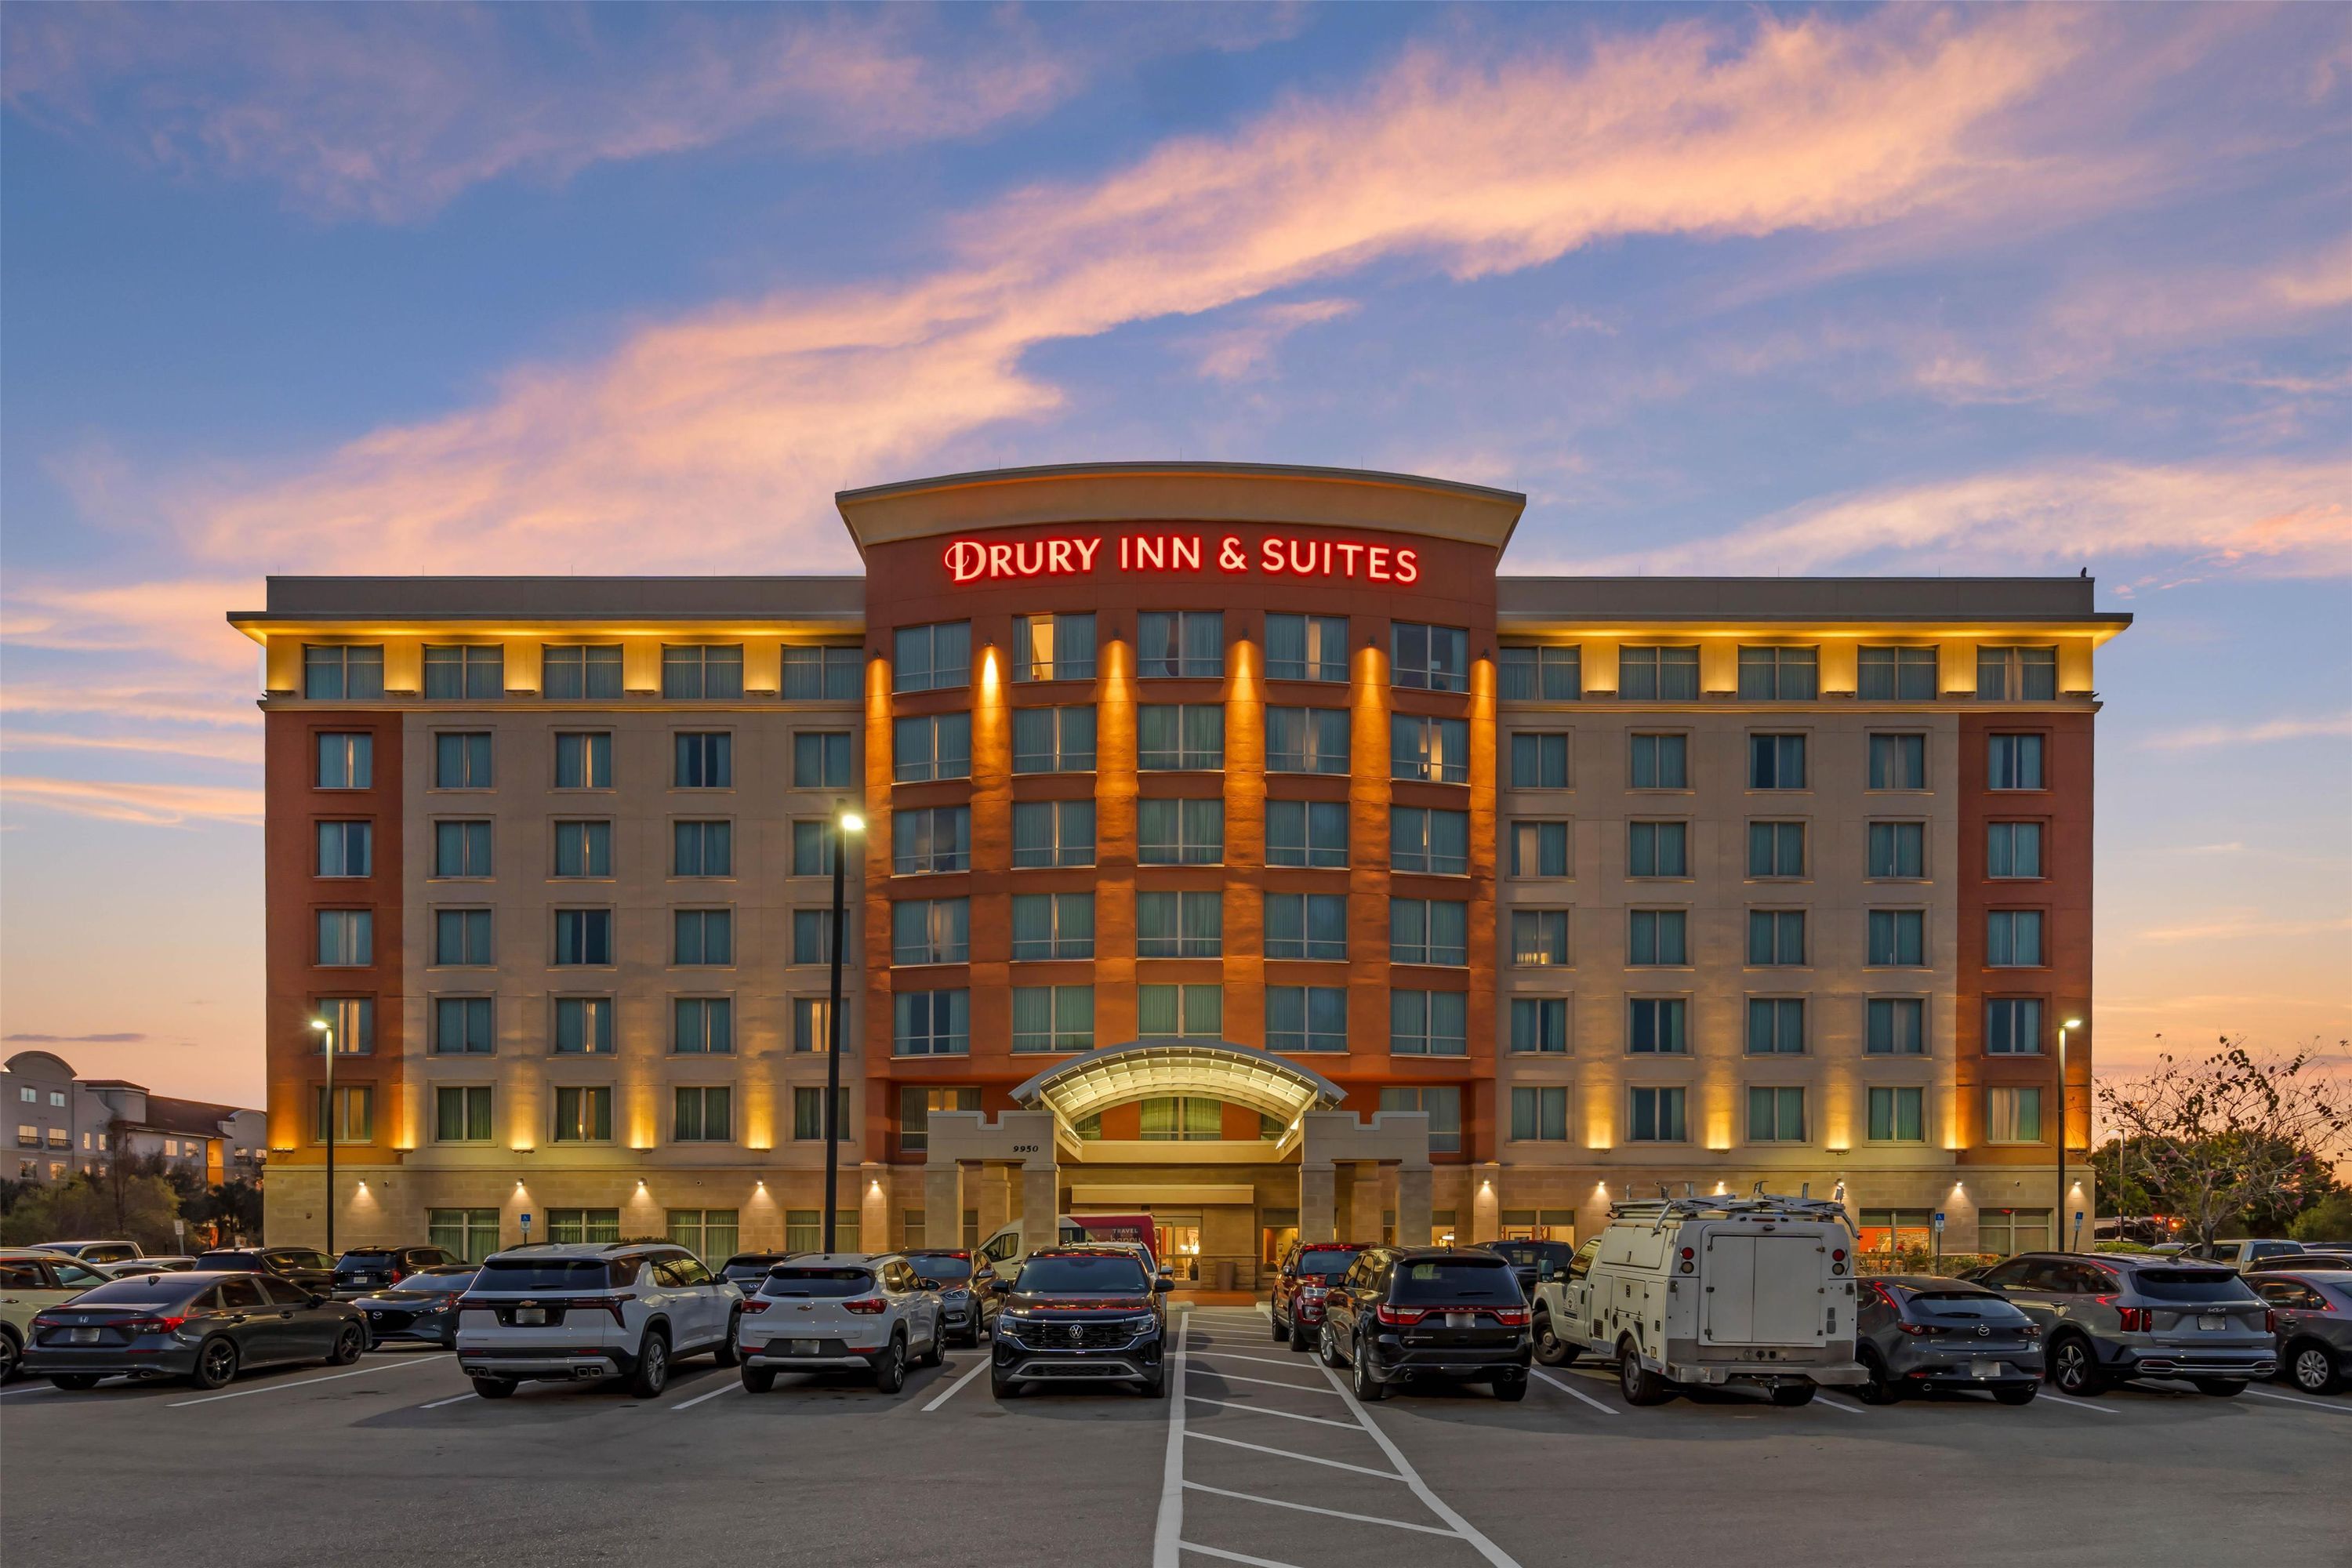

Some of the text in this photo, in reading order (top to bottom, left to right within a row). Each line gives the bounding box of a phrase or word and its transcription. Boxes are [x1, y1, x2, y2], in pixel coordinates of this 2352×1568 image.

[945, 537, 1417, 583] DRURY INN & SUITES
